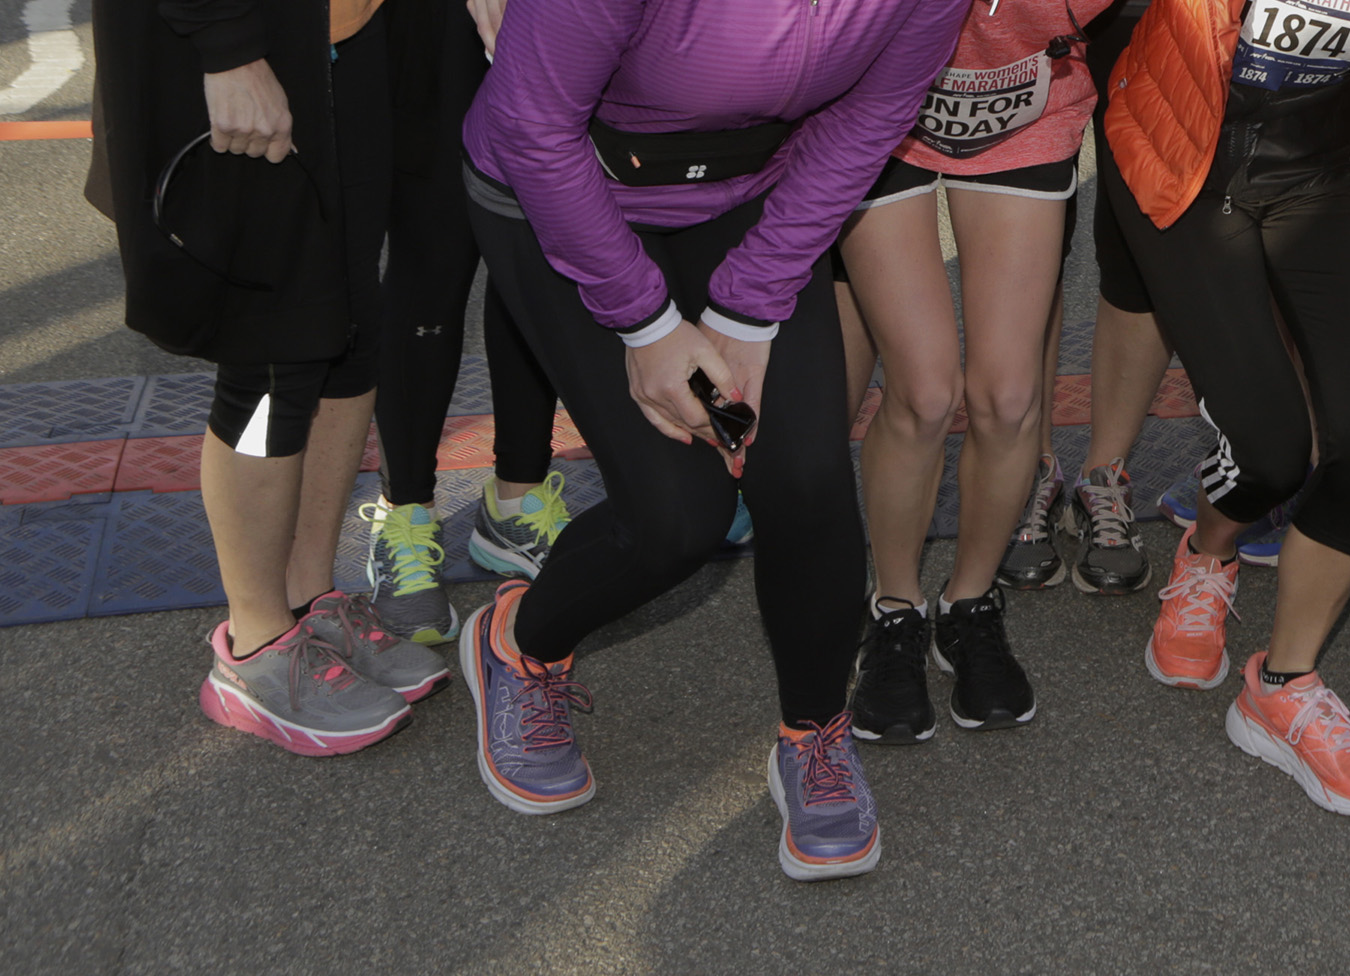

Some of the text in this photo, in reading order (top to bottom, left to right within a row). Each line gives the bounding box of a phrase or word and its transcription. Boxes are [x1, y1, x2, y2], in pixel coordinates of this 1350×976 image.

[952, 66, 1039, 92] MARATHON
[1239, 67, 1268, 83] 1874
[1294, 73, 1332, 84] 1874
[969, 91, 1034, 118] FOR
[918, 112, 1019, 138] ODAY
